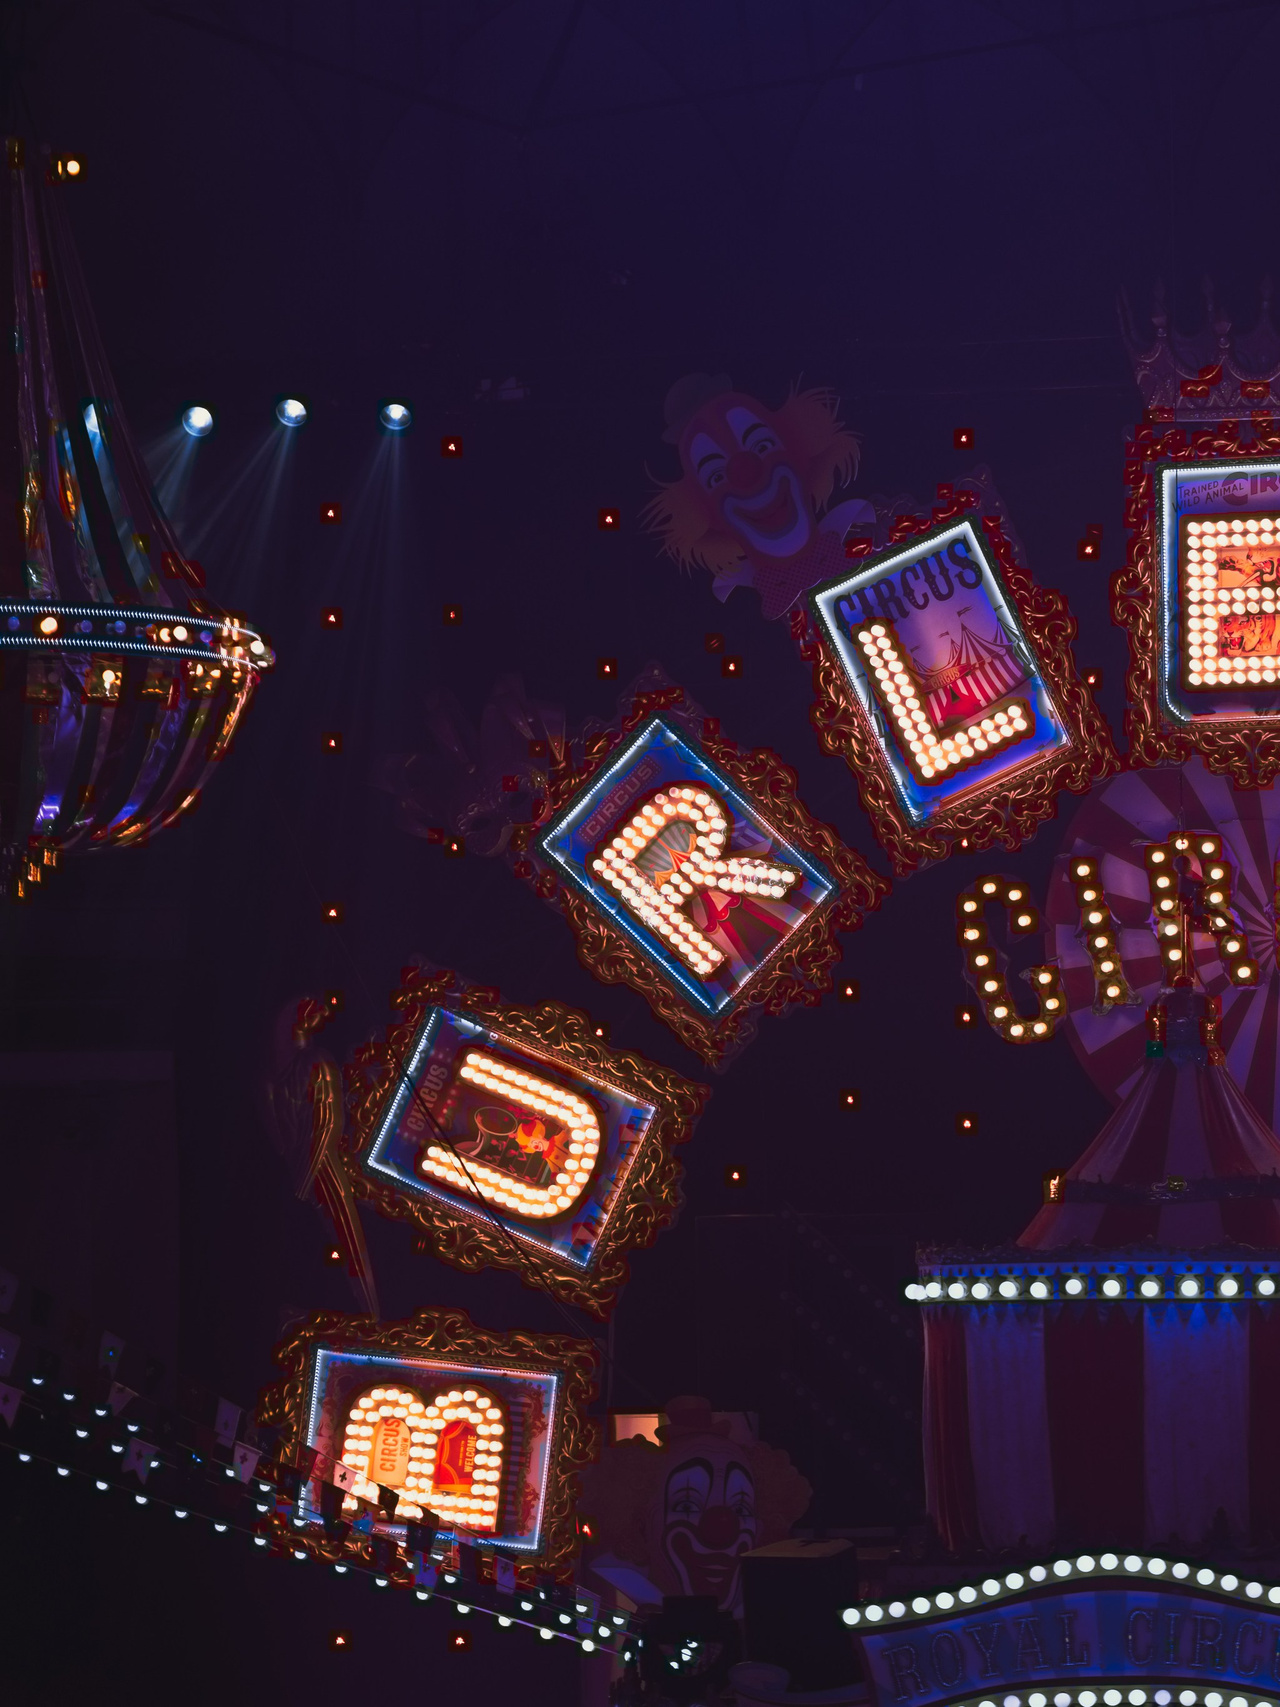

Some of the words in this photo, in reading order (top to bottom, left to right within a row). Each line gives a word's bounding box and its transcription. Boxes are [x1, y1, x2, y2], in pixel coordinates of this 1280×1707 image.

[1172, 496, 1200, 513] WILD
[1205, 483, 1244, 505] ANIMAL
[1178, 481, 1218, 500] TRAINED
[834, 536, 983, 633] CIRCUS
[930, 667, 960, 689] CIRCUS
[584, 763, 654, 835] CIRCUS
[406, 1063, 449, 1135] CIRCUS
[380, 1419, 401, 1472] CIRCUS
[400, 1437, 409, 1457] SHOW
[464, 1435, 477, 1473] WELCOME
[883, 1611, 1088, 1702] ROYAL
